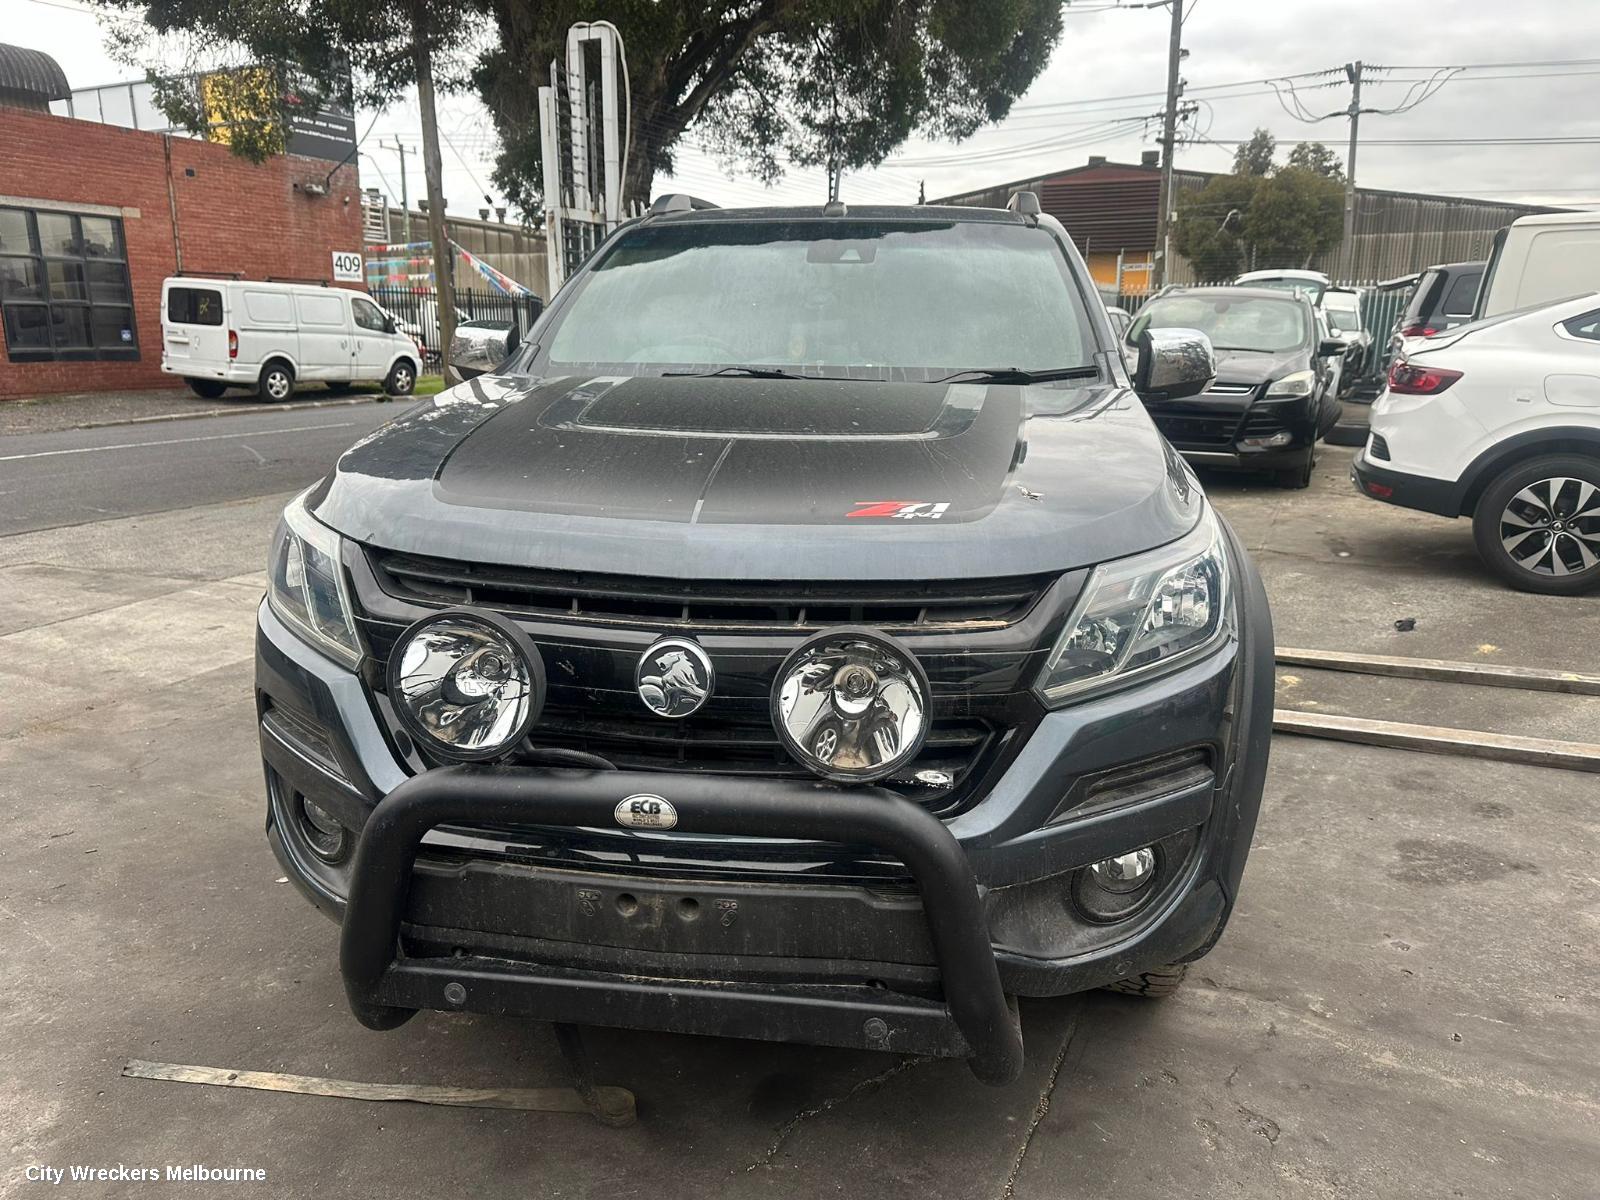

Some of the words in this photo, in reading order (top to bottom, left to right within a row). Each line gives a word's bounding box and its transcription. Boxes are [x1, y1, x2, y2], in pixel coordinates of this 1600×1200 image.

[335, 255, 360, 272] 409
[845, 501, 951, 518] Z71
[630, 800, 661, 814] ECB
